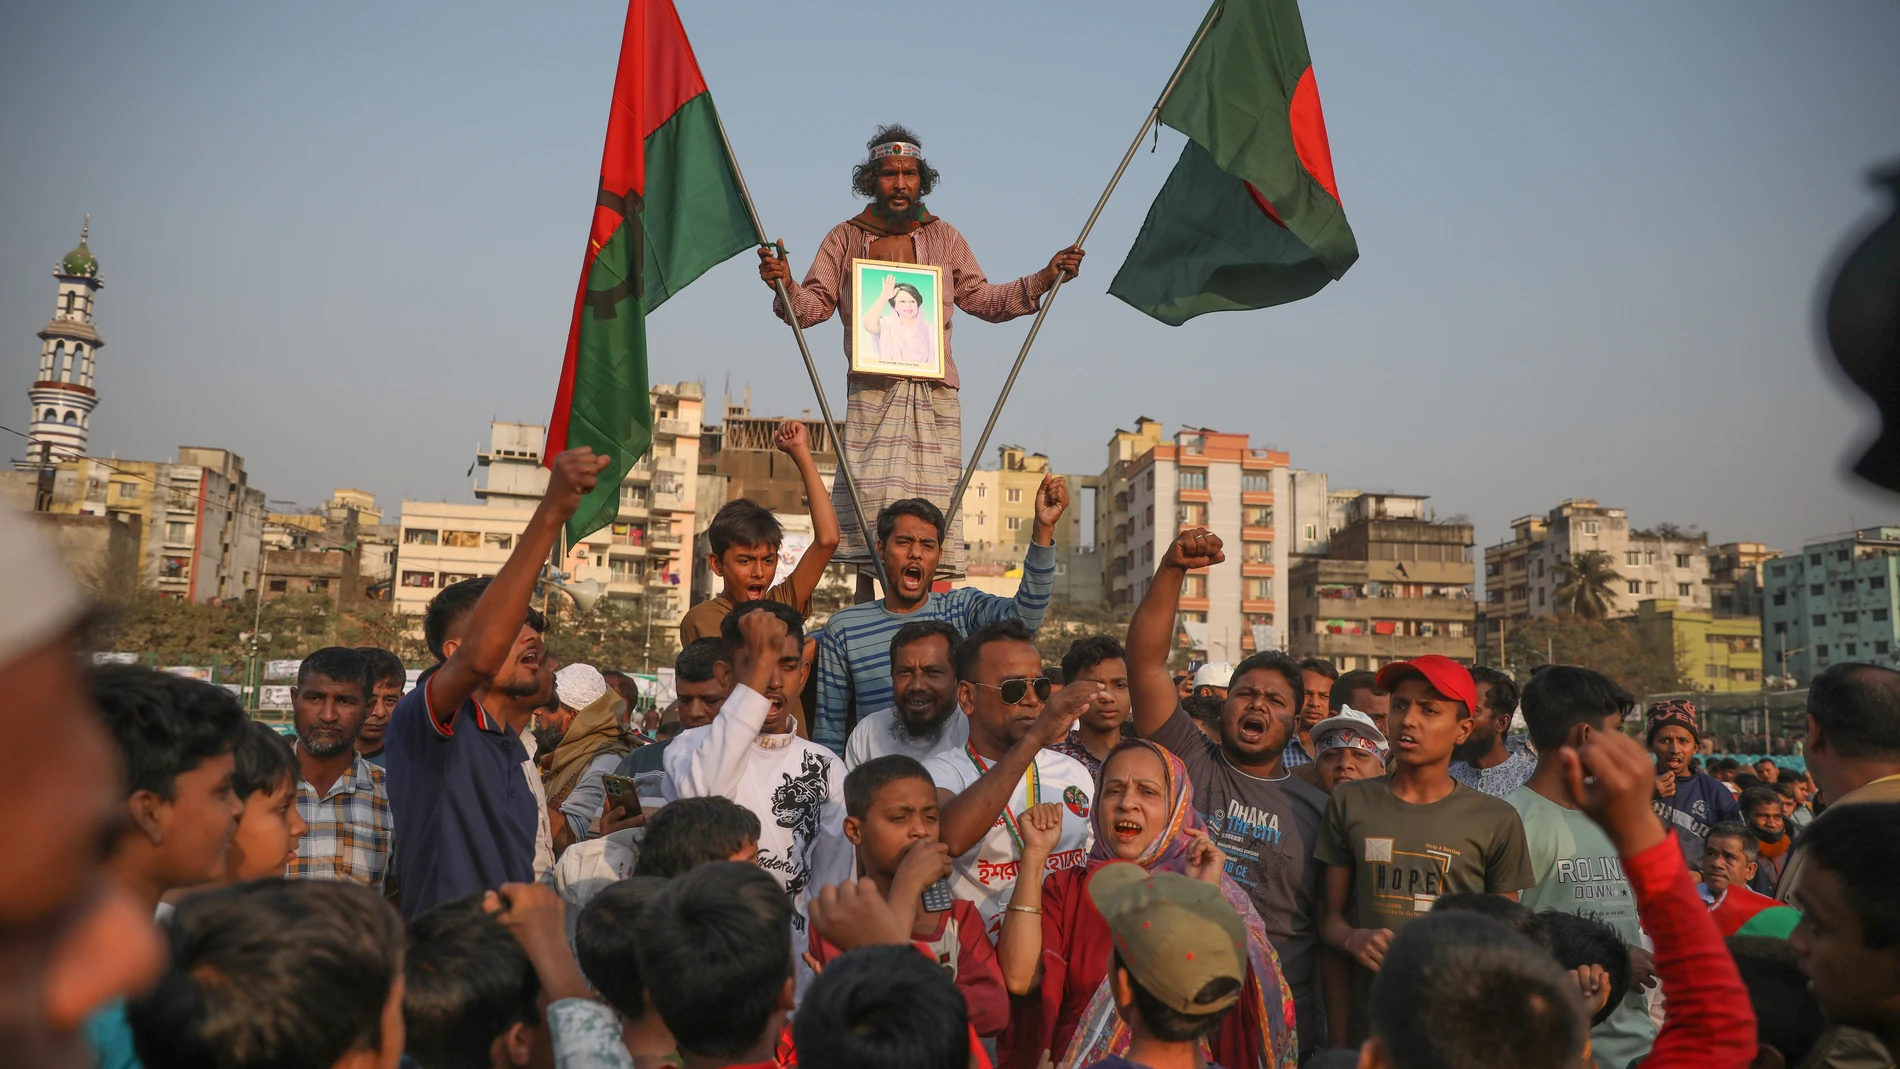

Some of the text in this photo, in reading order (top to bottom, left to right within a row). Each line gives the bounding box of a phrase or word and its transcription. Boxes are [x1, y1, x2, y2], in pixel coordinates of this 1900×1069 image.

[1227, 799, 1279, 832] DHAKA
[1227, 815, 1250, 834] THE
[1252, 824, 1282, 845] CITY
[1235, 864, 1248, 878] CE
[1378, 864, 1437, 895] HOPE
[1574, 885, 1612, 899] DOWN
